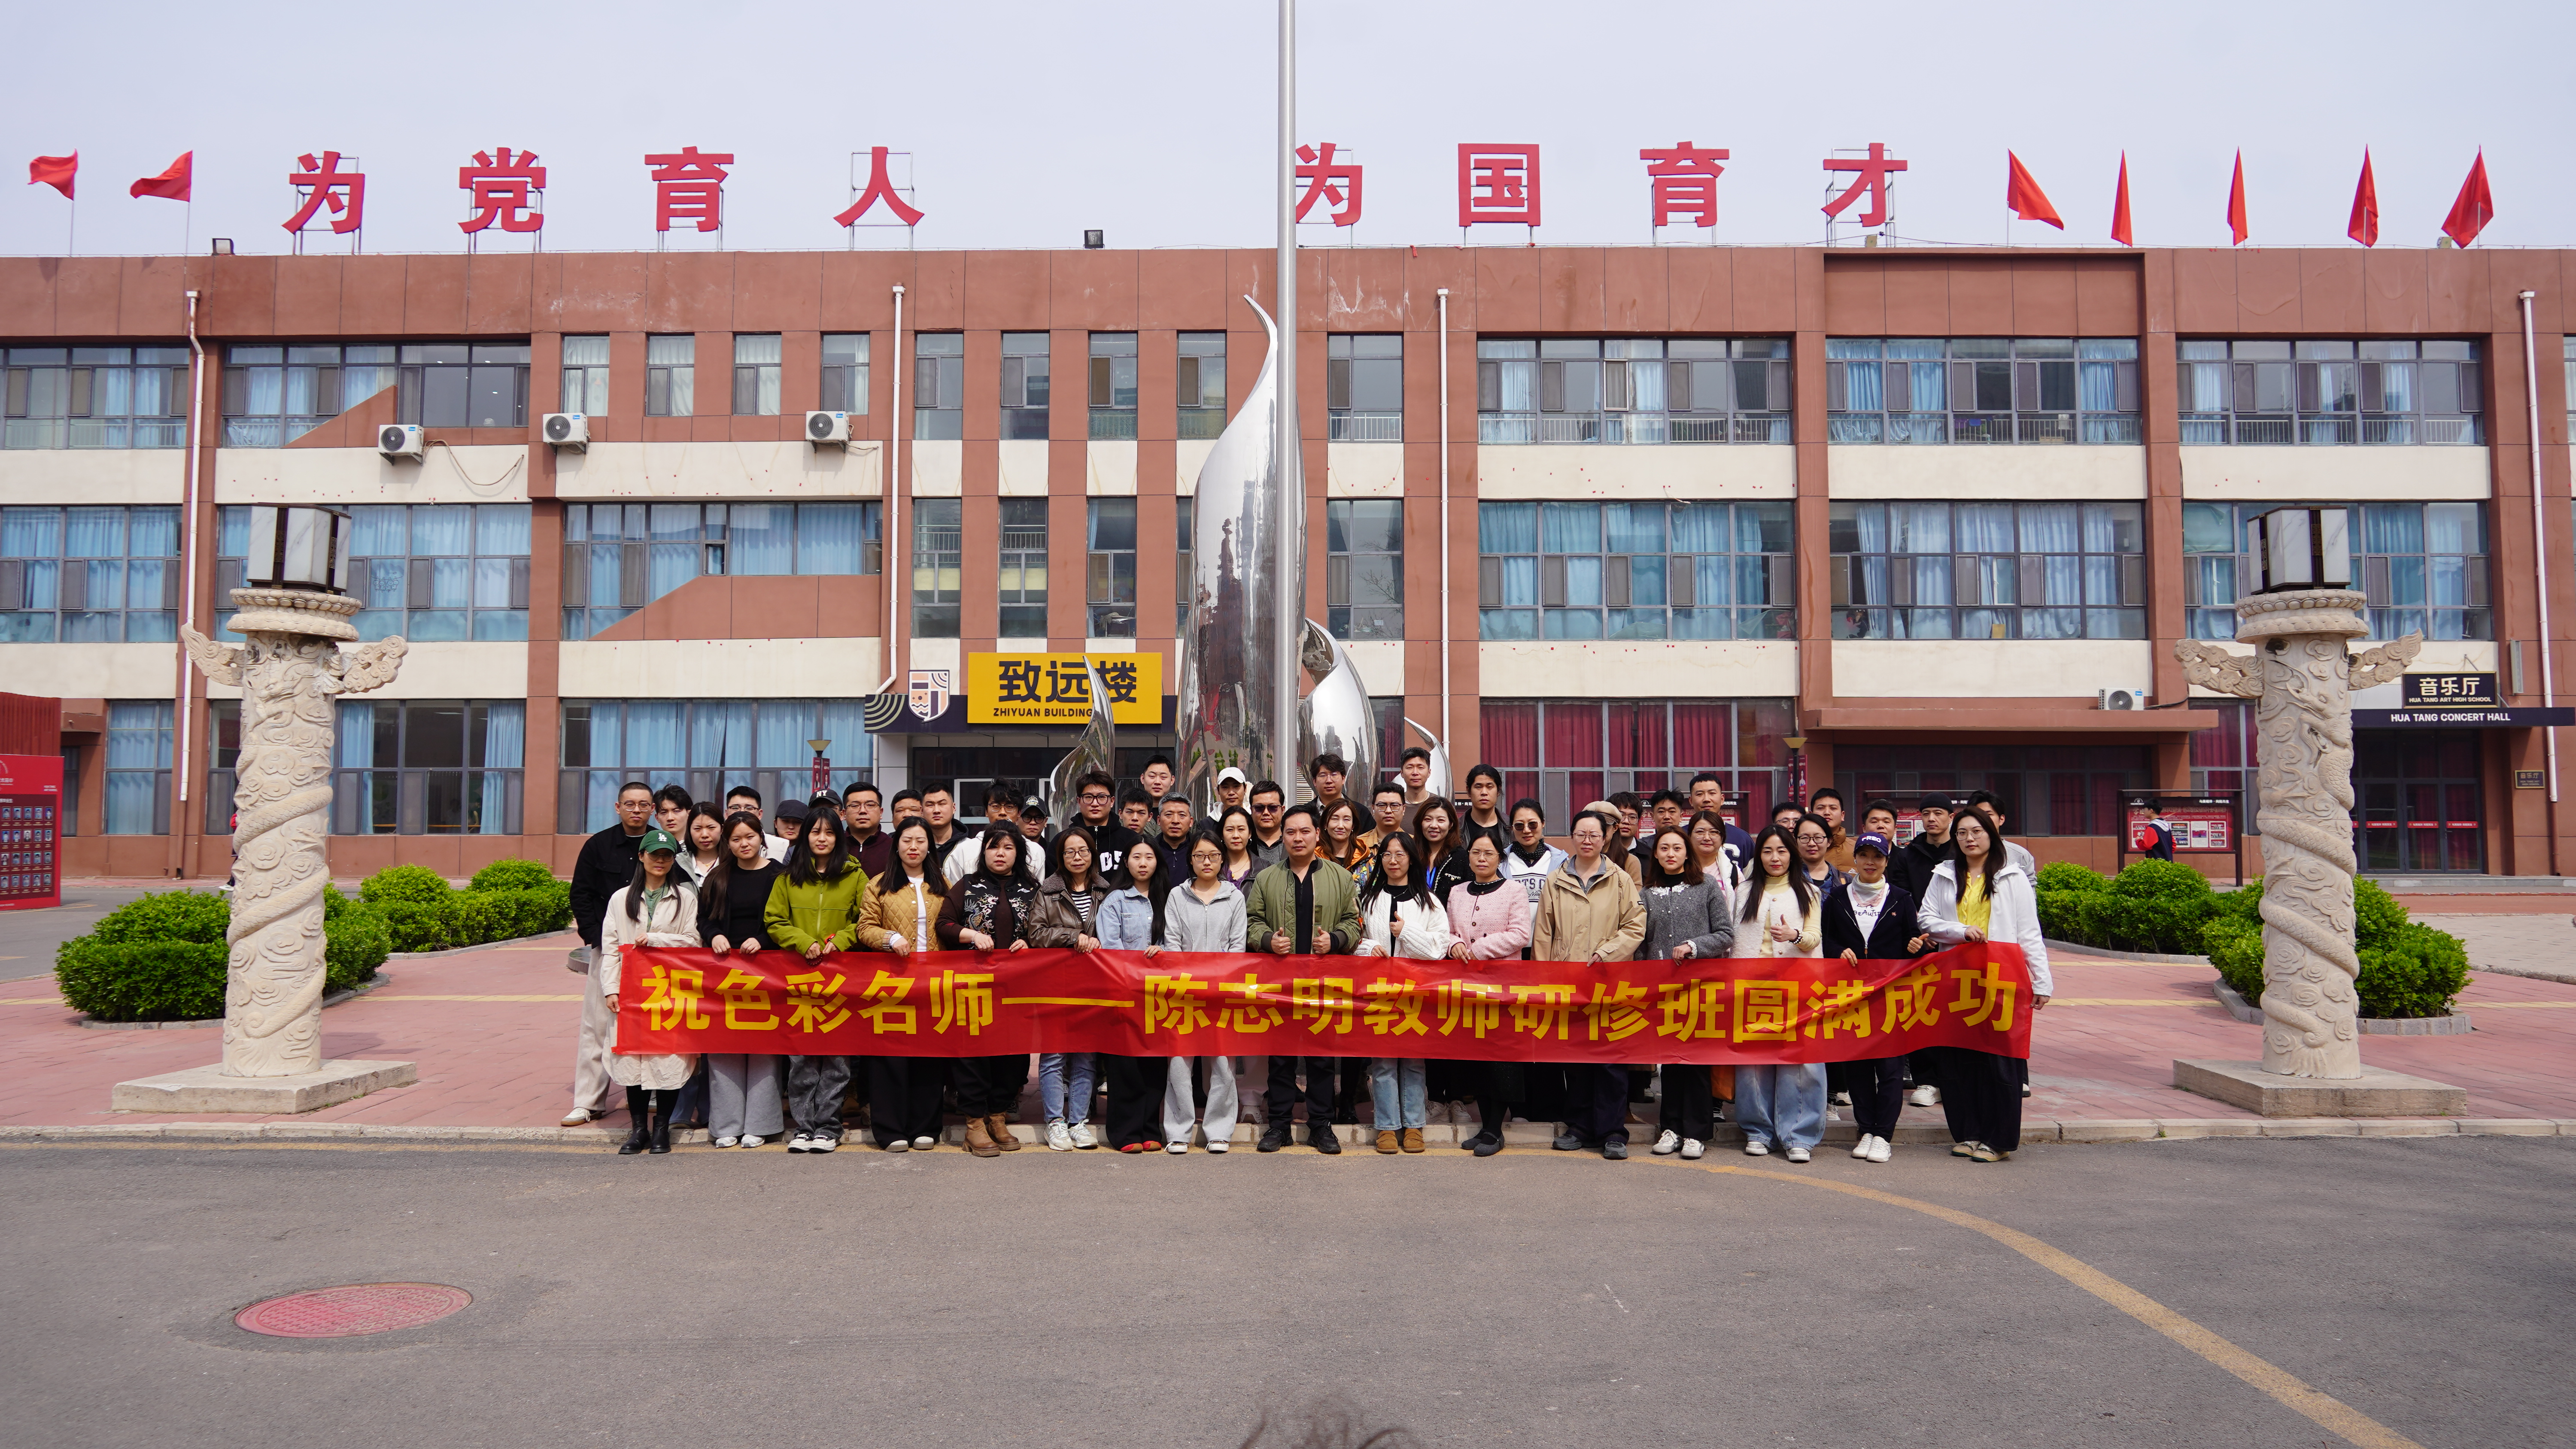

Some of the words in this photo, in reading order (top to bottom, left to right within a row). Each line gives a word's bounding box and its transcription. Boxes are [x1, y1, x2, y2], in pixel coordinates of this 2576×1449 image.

[282, 146, 923, 233] 为党育人
[1296, 141, 1908, 227] 为国育才
[999, 660, 1136, 703] 致远楼
[2419, 677, 2480, 696] 音乐厅
[993, 708, 1041, 717] ZHIYUAN
[1045, 708, 1093, 717] BUILDING
[2391, 714, 2411, 722] HUA
[2413, 713, 2438, 721] TANG
[2440, 713, 2485, 721] CONCERT
[2487, 713, 2511, 721] HALL
[816, 790, 828, 798] NY
[658, 833, 667, 842] LA
[1515, 878, 1535, 890] TS
